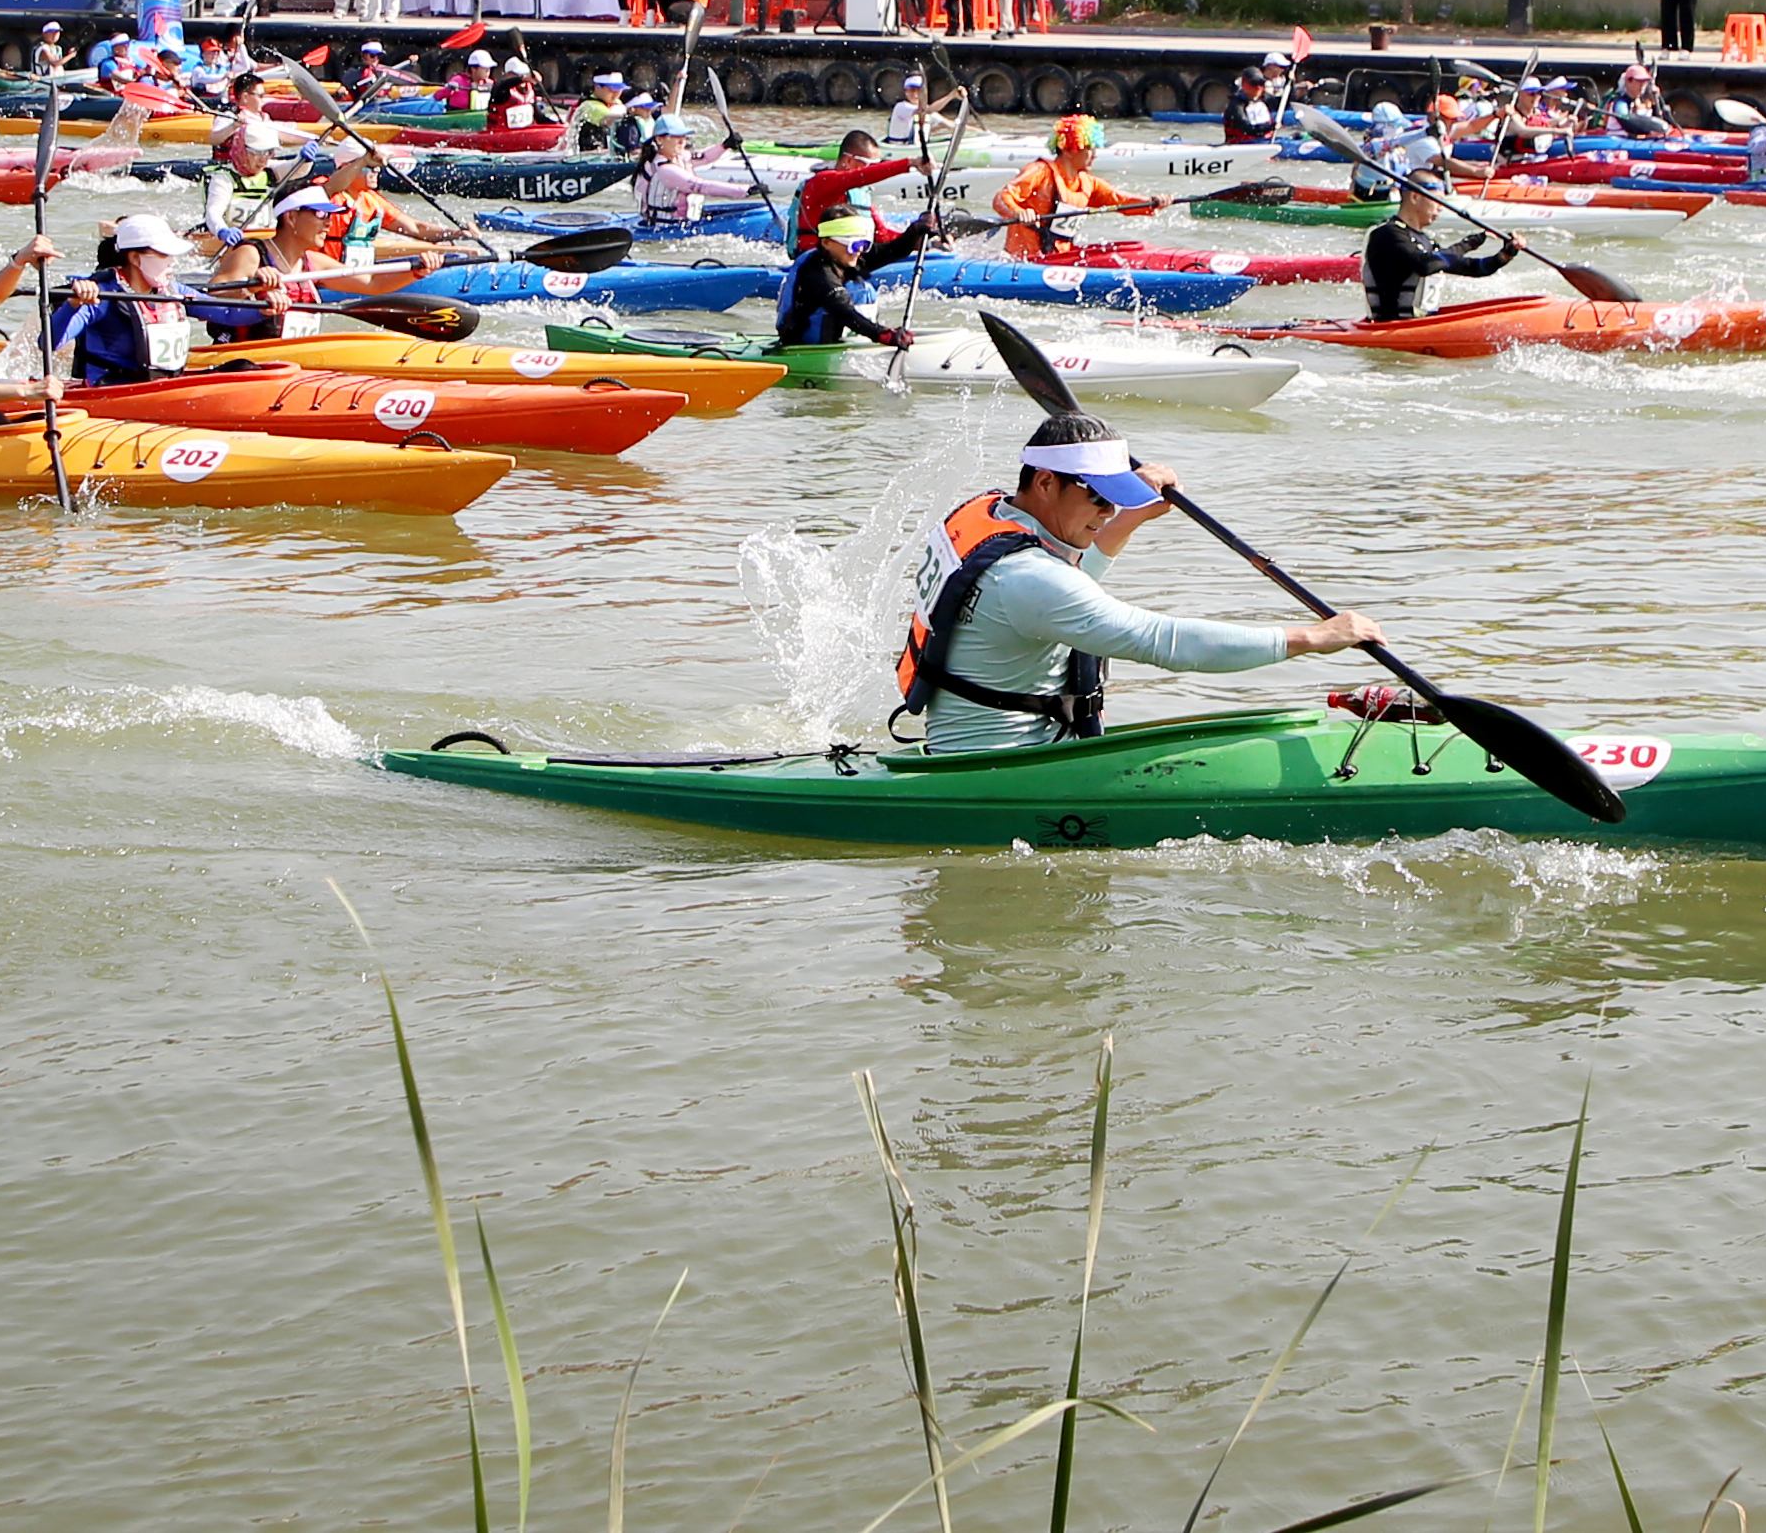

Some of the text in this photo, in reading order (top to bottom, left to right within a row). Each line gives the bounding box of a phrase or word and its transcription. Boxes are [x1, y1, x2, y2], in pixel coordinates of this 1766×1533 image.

[775, 170, 799, 181] 273
[1168, 158, 1233, 176] Liker
[518, 173, 592, 199] Liker
[547, 275, 581, 287] 244
[1047, 268, 1080, 283] 212
[515, 353, 558, 366] 240
[1052, 355, 1091, 372] 201
[379, 398, 426, 418] 200
[166, 447, 219, 468] 202
[1578, 742, 1658, 769] 230
